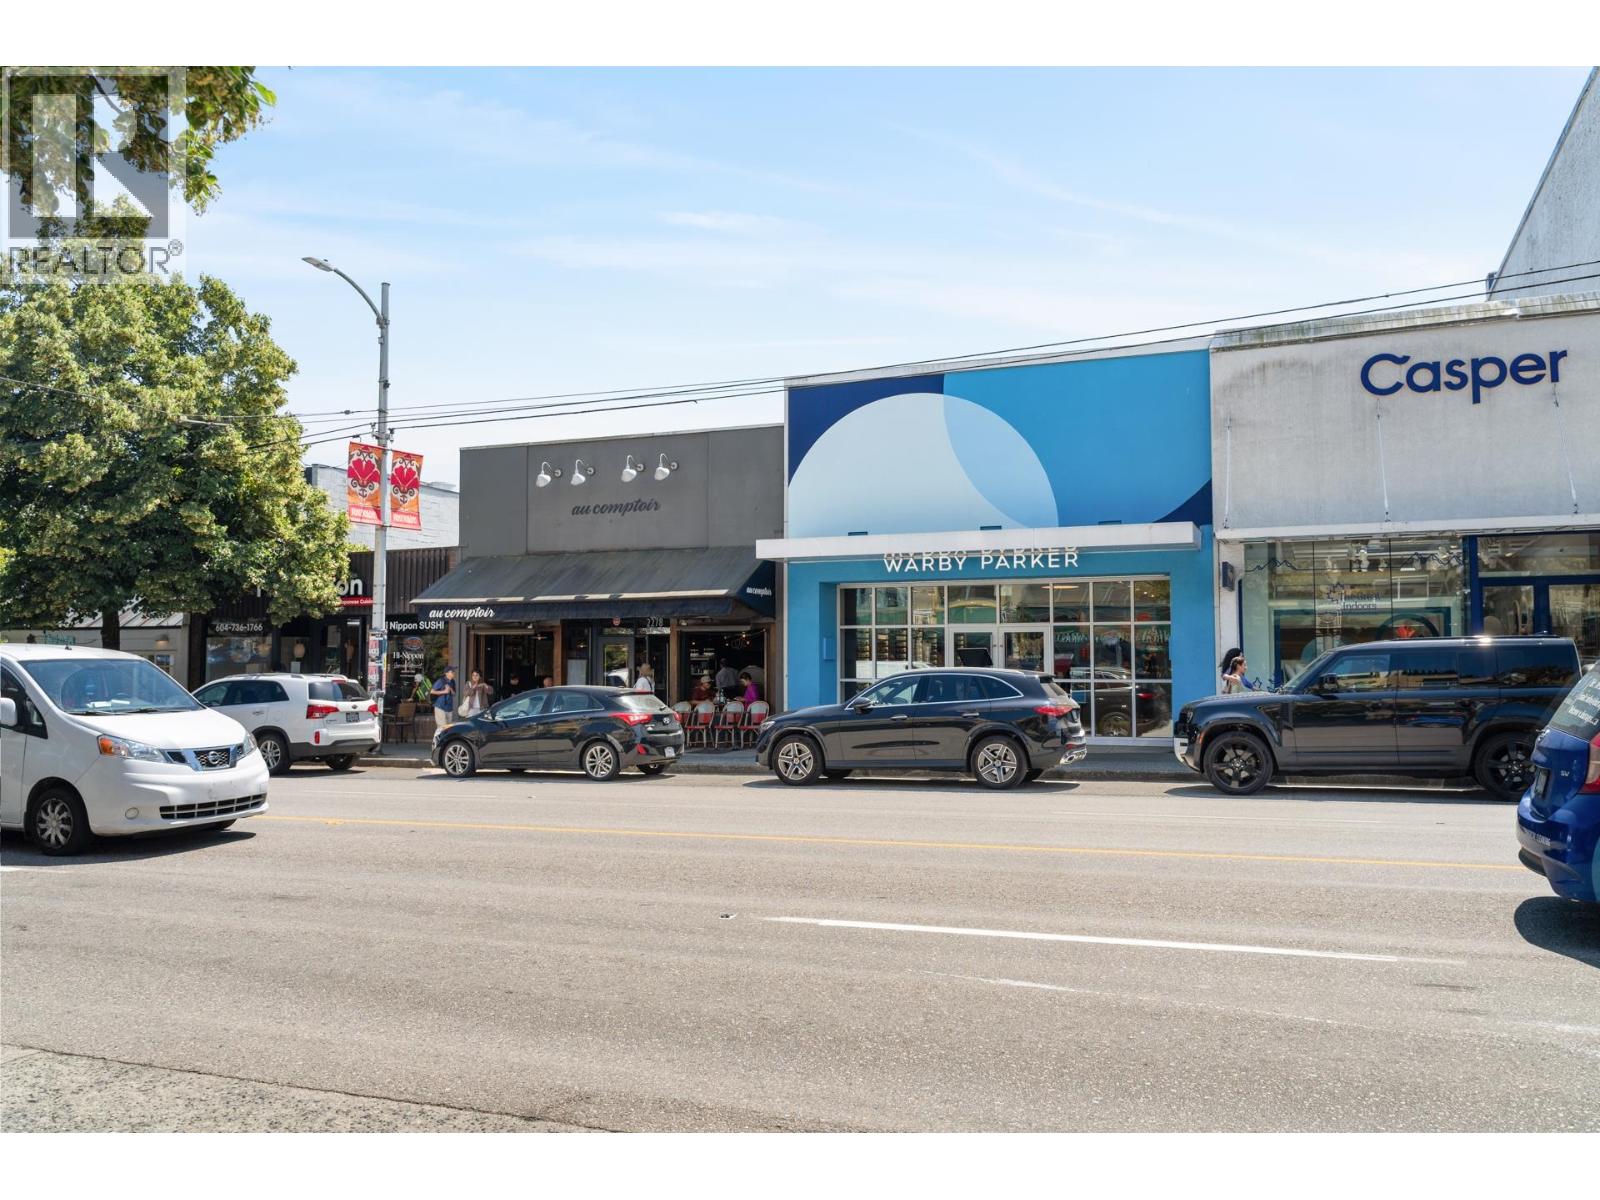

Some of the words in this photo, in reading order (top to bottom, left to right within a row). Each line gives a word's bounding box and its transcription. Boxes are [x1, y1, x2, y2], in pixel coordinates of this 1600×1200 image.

[1360, 349, 1568, 404] Casper
[571, 504, 591, 516] au
[592, 498, 660, 516] comptoir
[884, 555, 967, 573] WARBY
[981, 552, 1078, 569] PARKER
[429, 609, 443, 618] au
[444, 606, 496, 620] comptoir
[215, 623, 264, 632] 604-736-1766
[389, 621, 418, 632] Nippon
[419, 620, 445, 630] SUSHI
